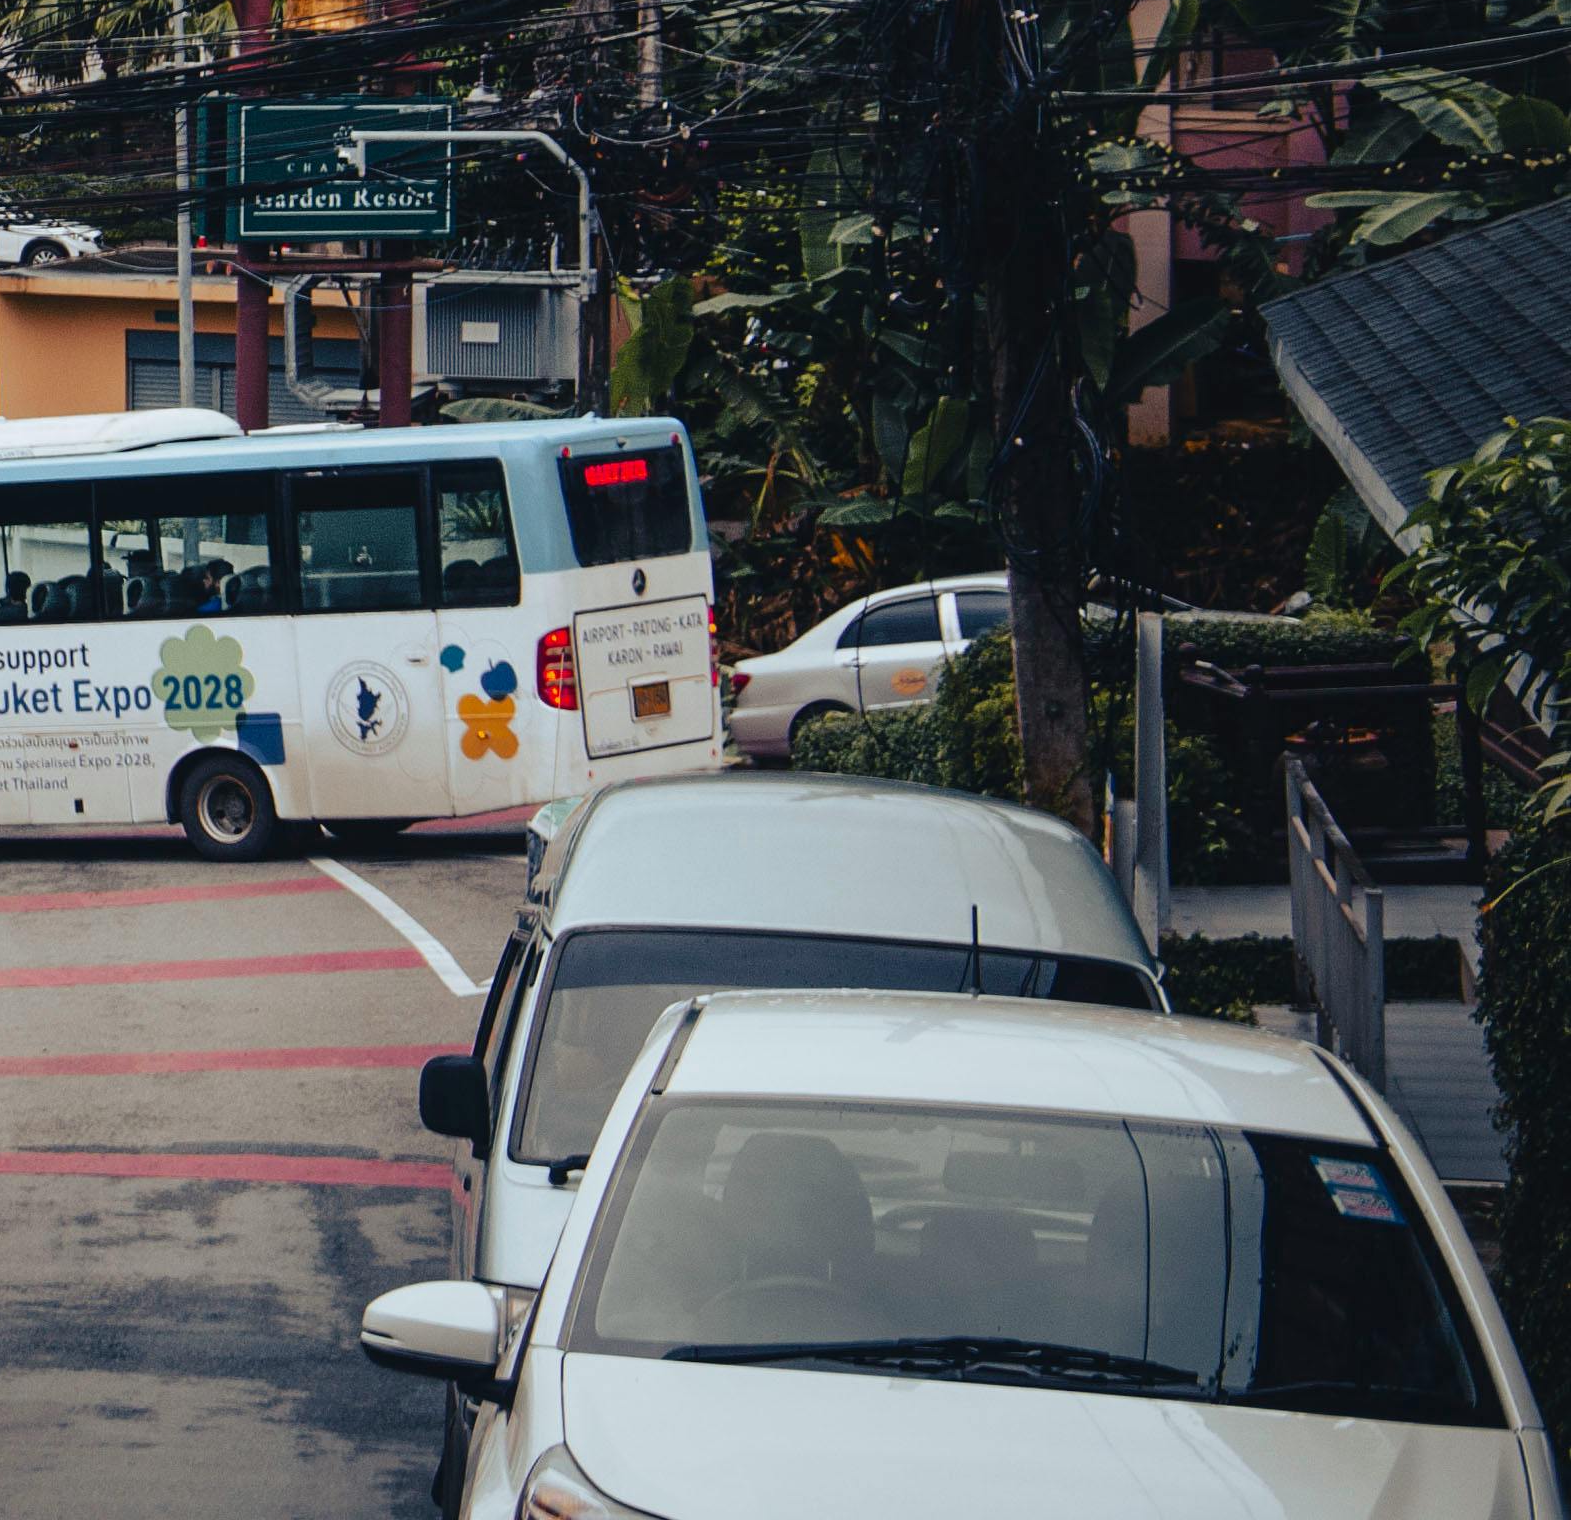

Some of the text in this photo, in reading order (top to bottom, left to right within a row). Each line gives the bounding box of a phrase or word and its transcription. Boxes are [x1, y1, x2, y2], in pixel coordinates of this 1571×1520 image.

[353, 186, 436, 209] Resort
[583, 612, 703, 643] AIRPORT PATONG KATA
[608, 640, 683, 665] KARON RAWAI
[73, 679, 152, 718] Expo
[163, 674, 244, 710] 2028
[15, 756, 76, 770] Specialised
[79, 754, 112, 771] Expo
[12, 776, 69, 791] Thailand
